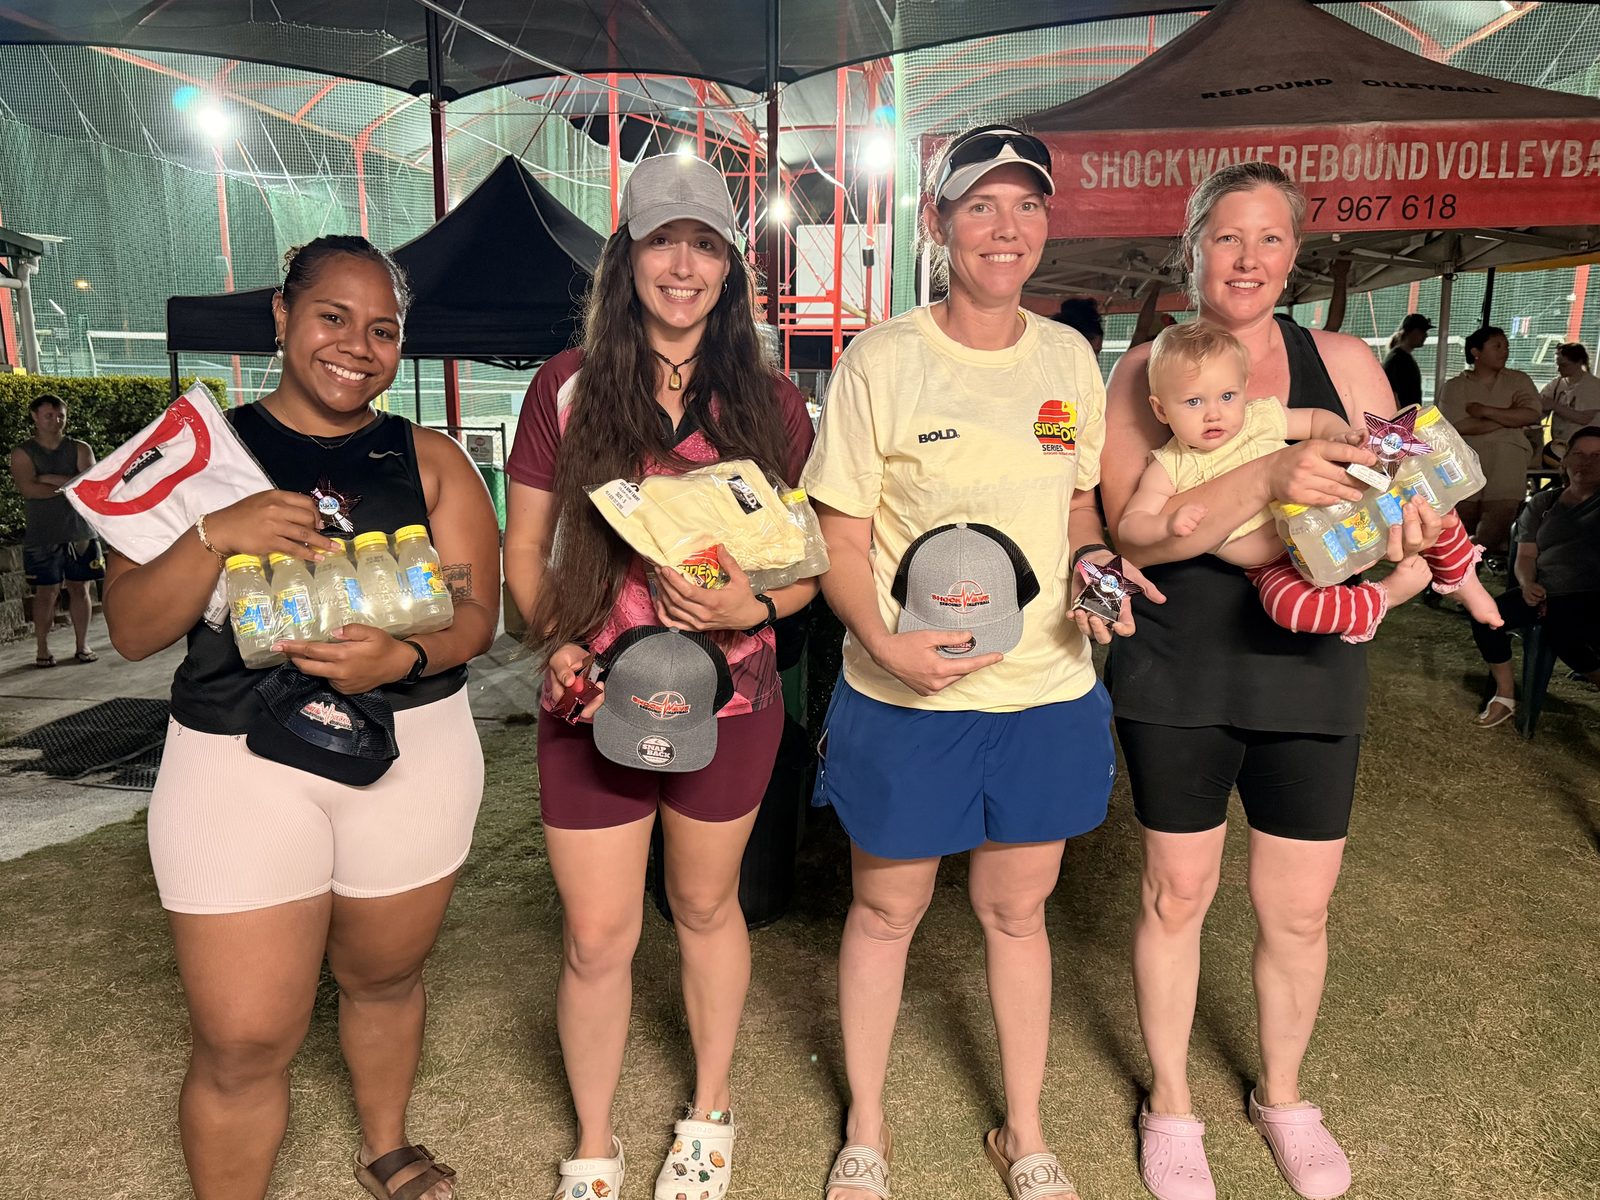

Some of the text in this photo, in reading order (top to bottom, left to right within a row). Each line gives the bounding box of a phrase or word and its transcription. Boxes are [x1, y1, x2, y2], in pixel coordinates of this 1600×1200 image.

[1201, 78, 1333, 99] REBOUND
[1080, 149, 1184, 189] SHOCK
[1278, 142, 1429, 183] REBOUND
[1337, 195, 1392, 222] 967
[1402, 194, 1457, 220] 618
[1042, 444, 1063, 452] SERIES
[647, 750, 670, 758] BACK
[1015, 1163, 1066, 1195] ROX
